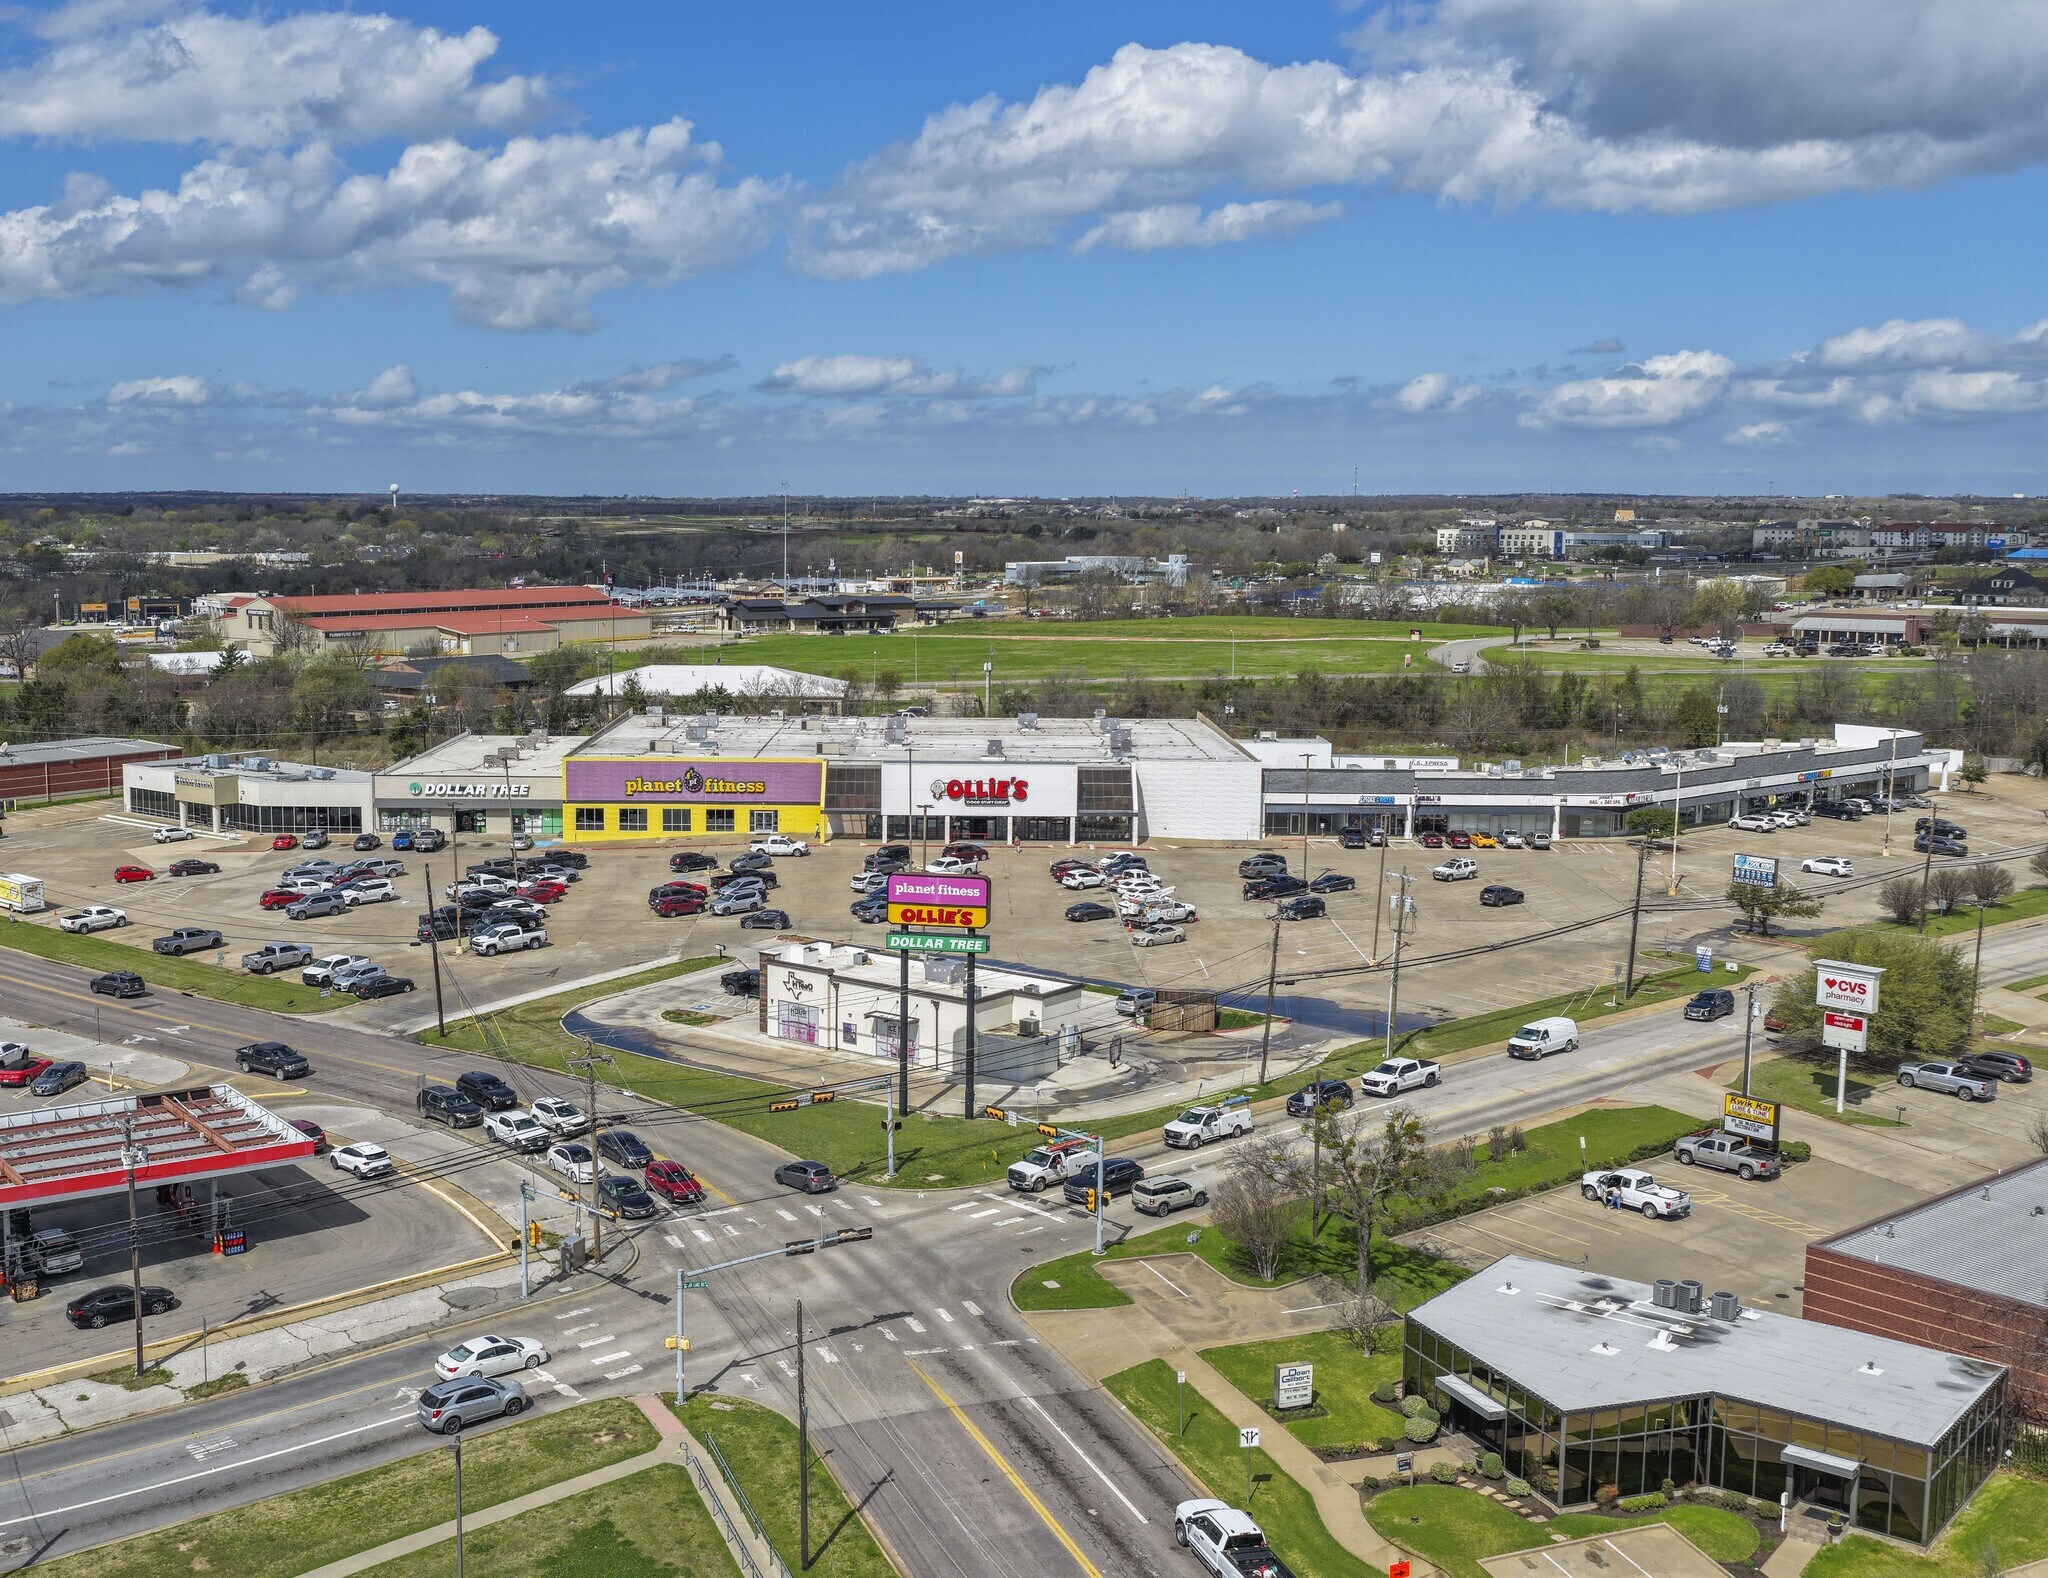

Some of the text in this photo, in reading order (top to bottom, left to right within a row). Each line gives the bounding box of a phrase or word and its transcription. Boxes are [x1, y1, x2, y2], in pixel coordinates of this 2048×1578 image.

[424, 783, 530, 797] DOLLAR TREE
[625, 777, 683, 796] planet
[704, 778, 766, 794] fitness
[946, 777, 1028, 801] OLLIE'S
[895, 882, 980, 897] planet fitness
[900, 908, 974, 926] OLLIE'S
[890, 936, 983, 951] DOLLAR TREE
[1838, 980, 1867, 996] CVS
[1825, 991, 1866, 1006] pharmacy
[1730, 1096, 1773, 1112] Kwik Kar
[1731, 1104, 1746, 1113] LUBE
[1752, 1109, 1768, 1118] TUNE
